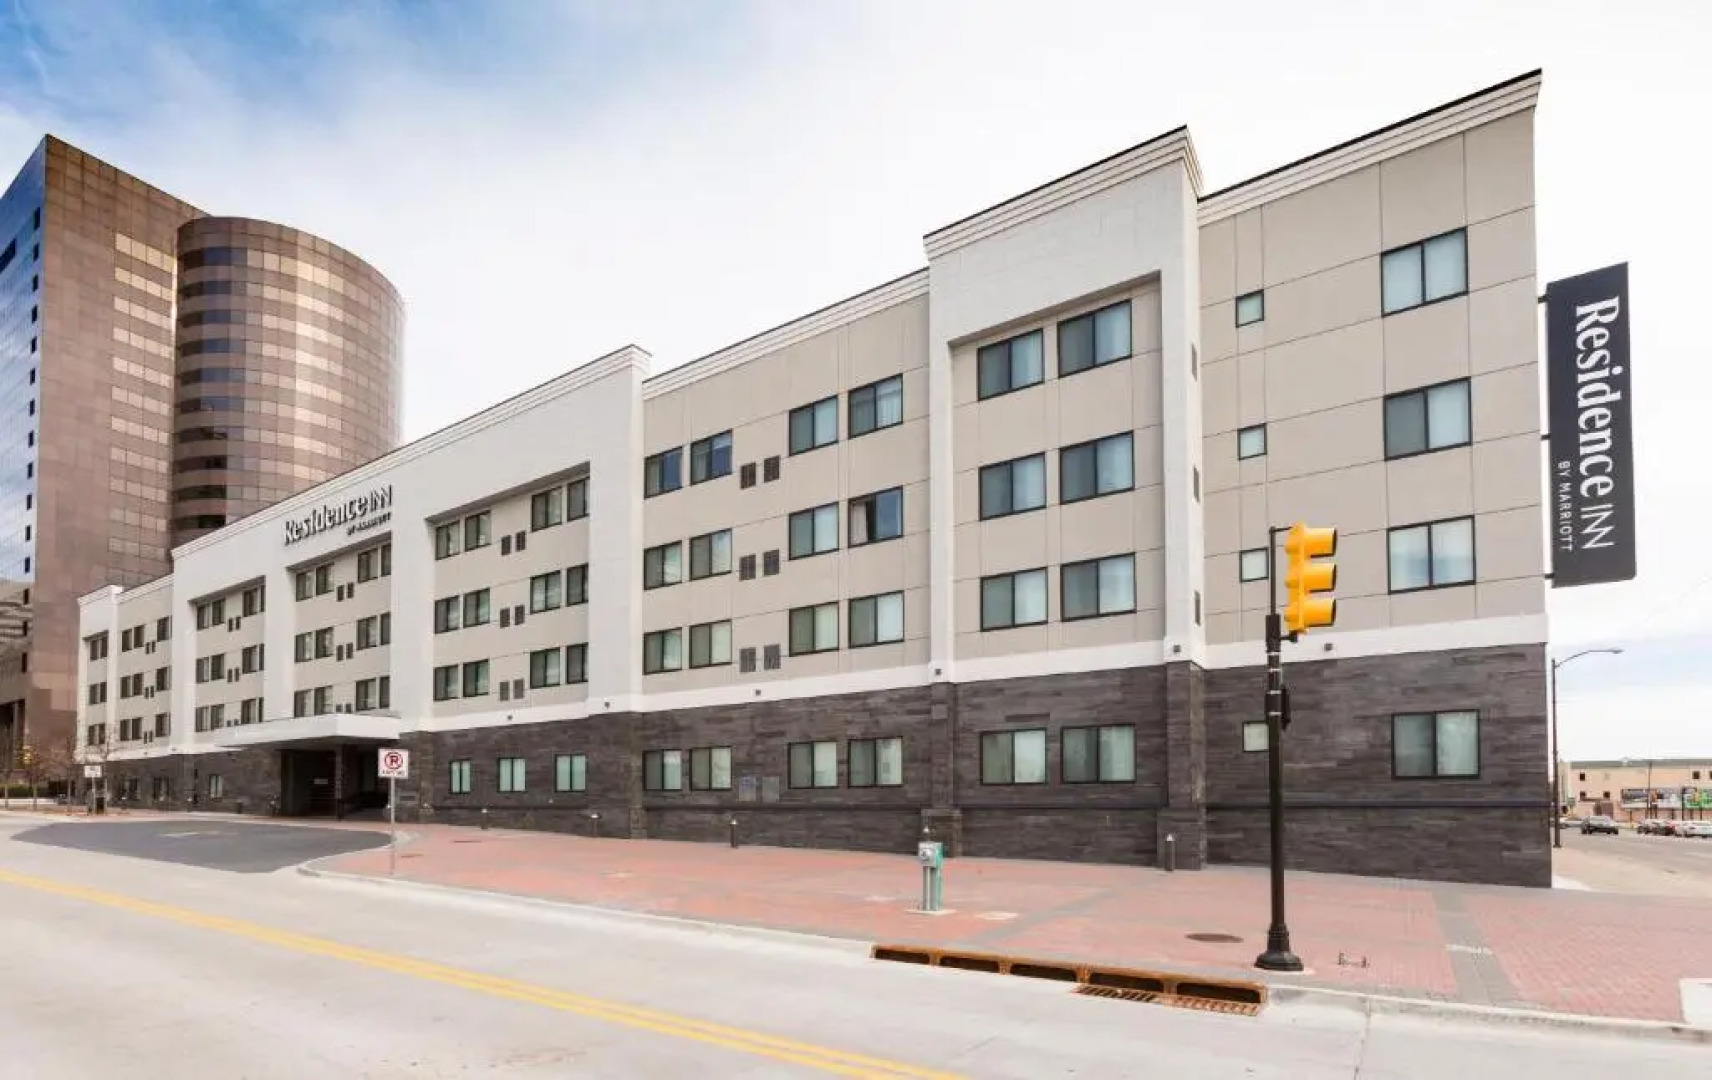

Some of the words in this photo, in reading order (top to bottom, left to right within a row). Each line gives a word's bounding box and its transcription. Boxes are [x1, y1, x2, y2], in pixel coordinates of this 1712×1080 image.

[1575, 296, 1623, 498] Residence
[1558, 460, 1571, 477] BY
[284, 496, 368, 546] Residence
[1559, 482, 1573, 552] MARRIOTT
[1580, 503, 1615, 549] INN
